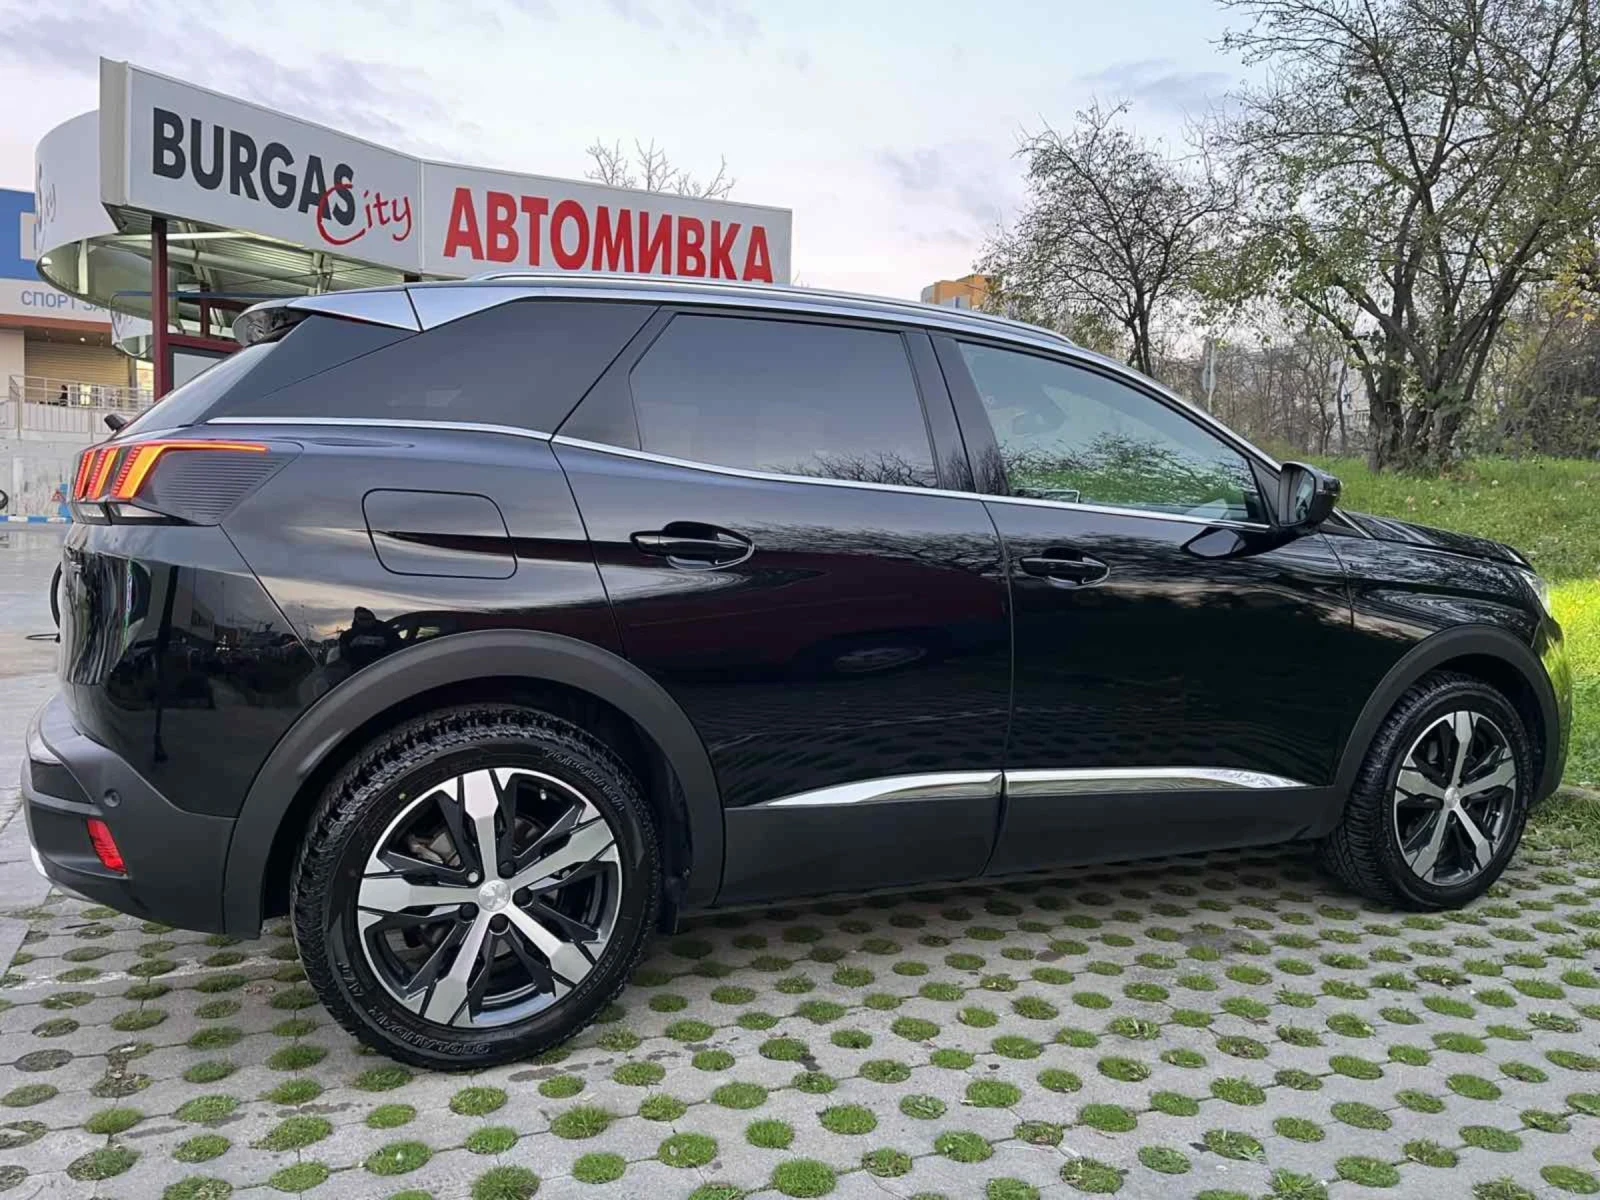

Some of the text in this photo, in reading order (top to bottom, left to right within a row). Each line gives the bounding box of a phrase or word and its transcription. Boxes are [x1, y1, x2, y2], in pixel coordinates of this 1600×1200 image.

[153, 107, 356, 226] BURGAS
[316, 183, 413, 246] City
[443, 187, 774, 284] АВТОМИВКА
